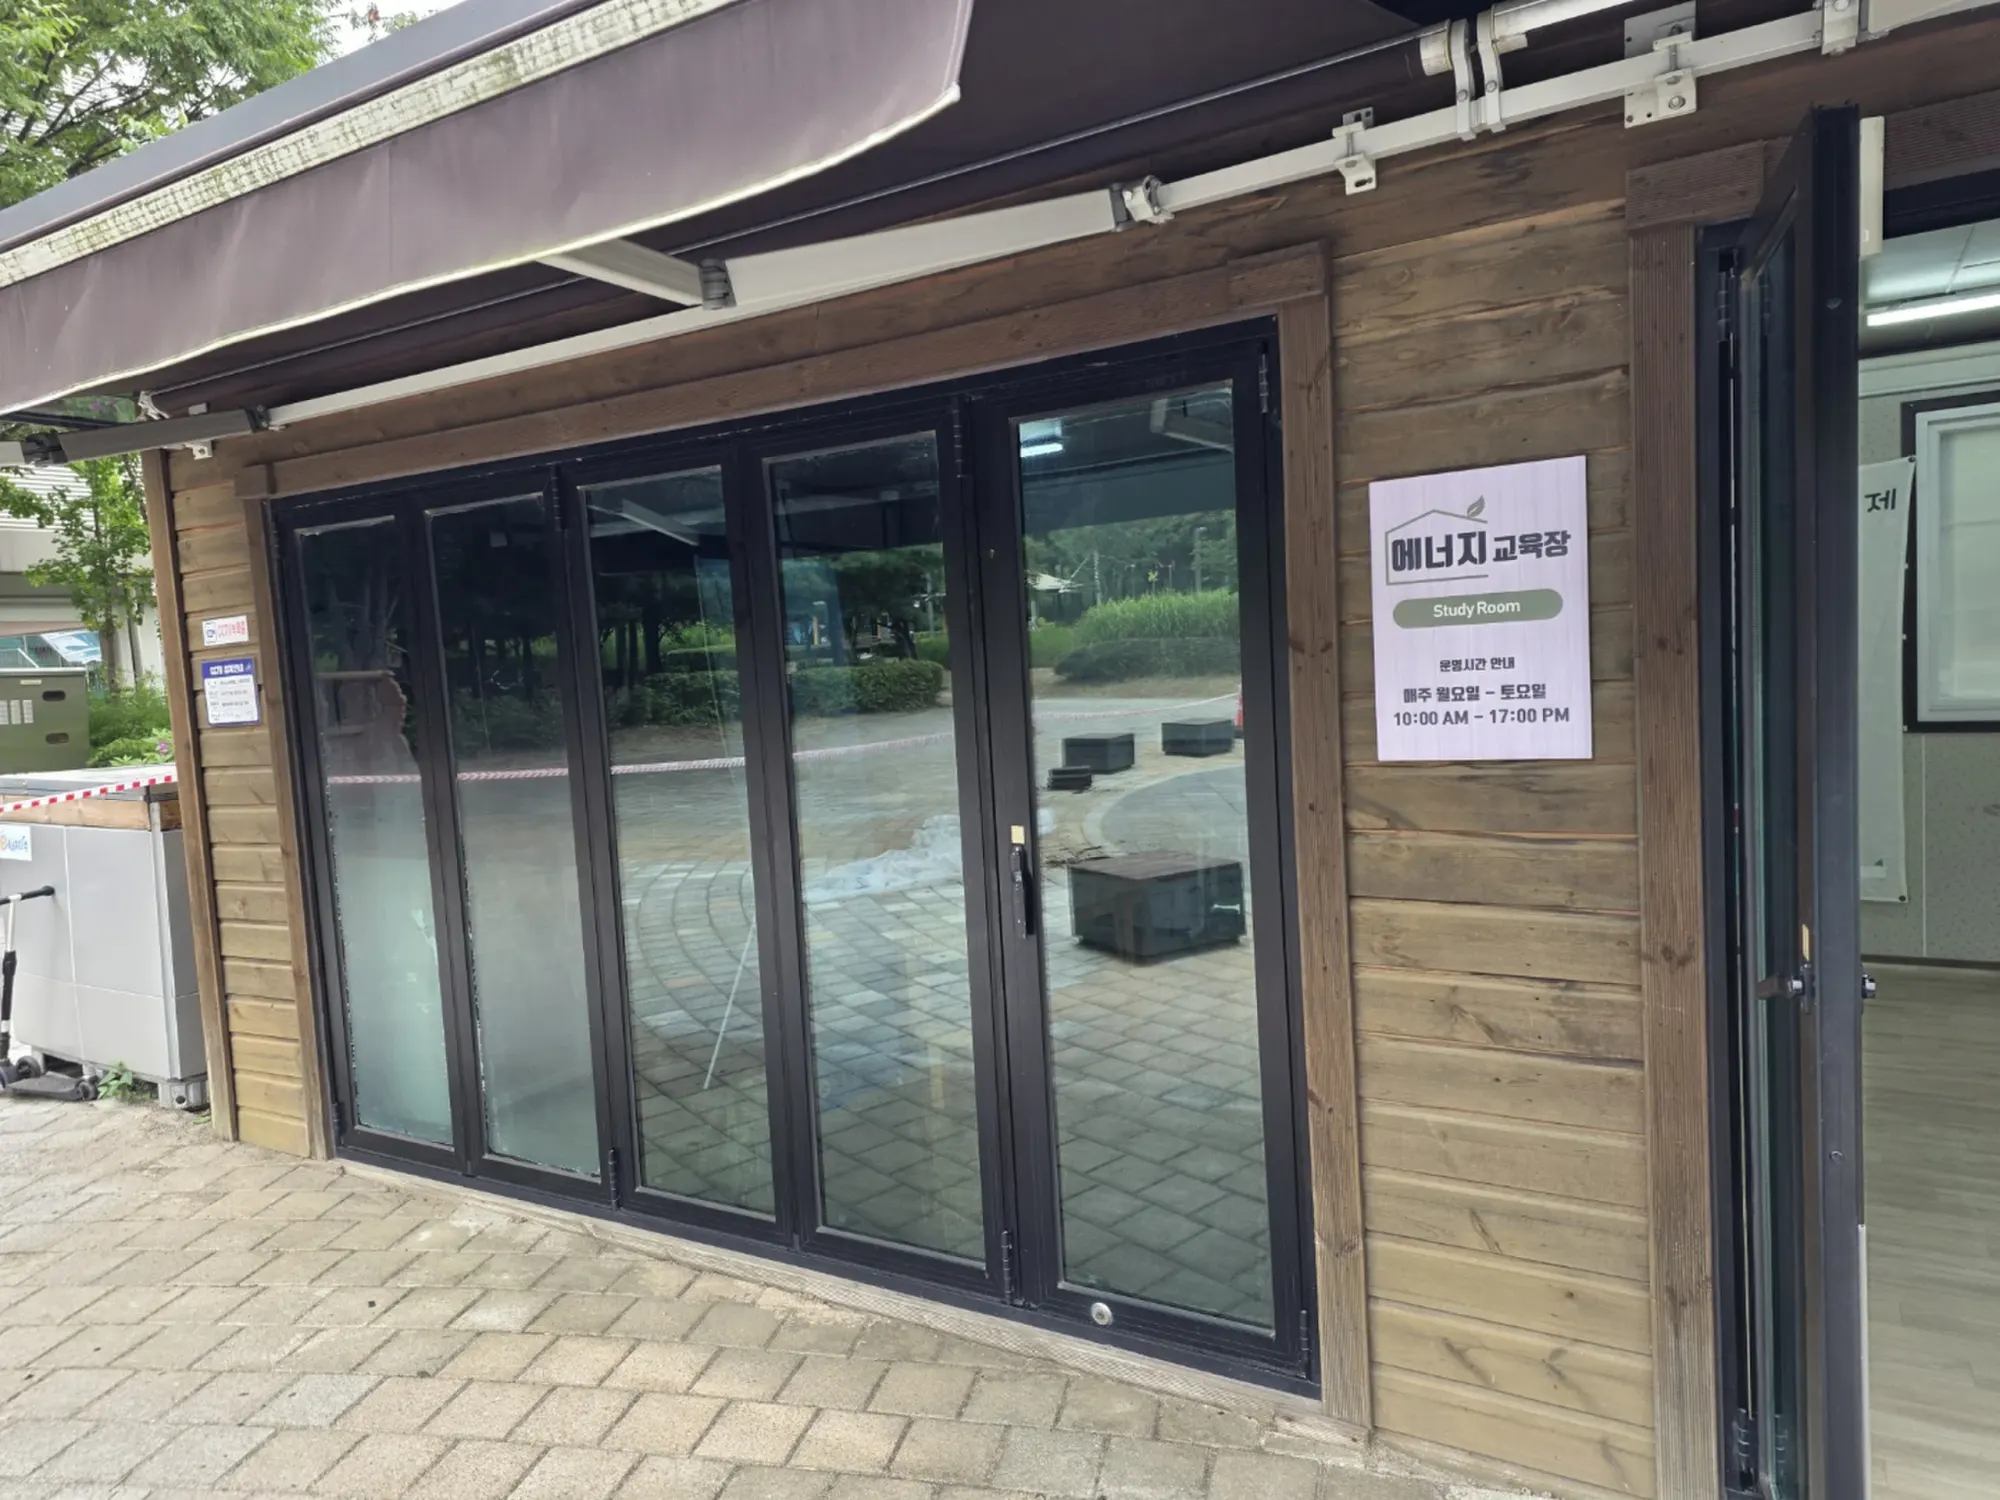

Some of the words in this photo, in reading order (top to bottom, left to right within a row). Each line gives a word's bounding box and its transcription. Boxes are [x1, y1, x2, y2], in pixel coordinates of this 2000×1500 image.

[1864, 488, 1897, 513] 제
[1391, 531, 1487, 572] 에너지
[1492, 530, 1572, 563] 교육장
[1433, 603, 1475, 619] Study
[1476, 601, 1521, 615] Room
[1490, 656, 1515, 670] 안내
[1403, 687, 1432, 703] 매주
[1436, 685, 1481, 702] 월요일
[1500, 683, 1547, 700] 토요일
[1394, 711, 1439, 726] 10:00
[1442, 710, 1469, 725] AM
[1489, 708, 1537, 724] 17:00
[1542, 707, 1570, 722] PM
